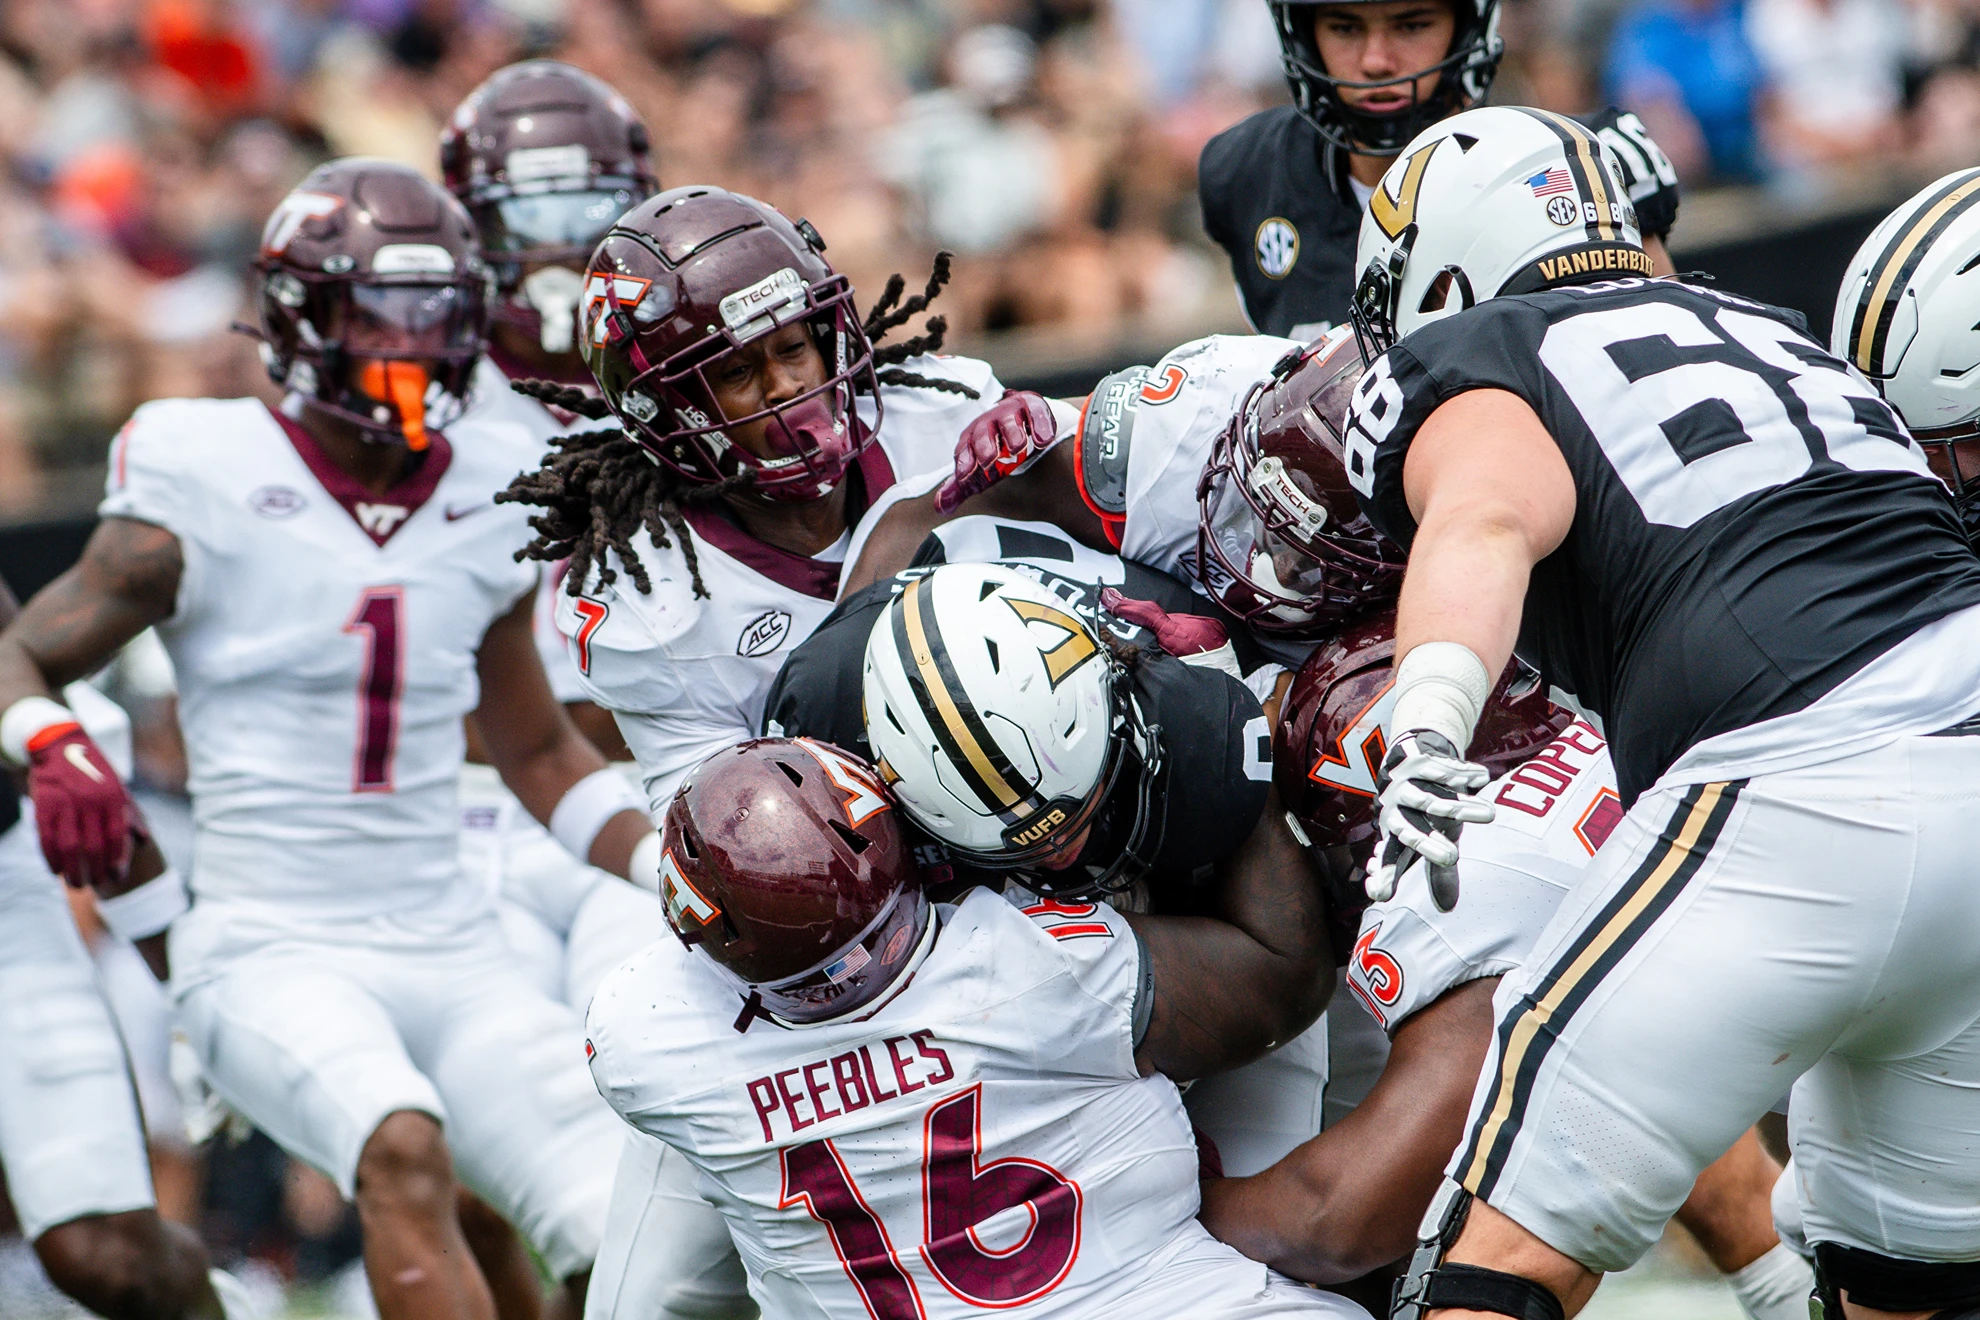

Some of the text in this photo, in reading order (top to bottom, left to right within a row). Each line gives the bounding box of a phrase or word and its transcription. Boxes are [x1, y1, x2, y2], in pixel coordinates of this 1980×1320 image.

[1597, 112, 1678, 202] 16
[1257, 221, 1295, 275] SEC
[1548, 197, 1576, 225] SEC
[738, 279, 780, 307] TECH
[1099, 381, 1126, 463] GEAR
[1342, 353, 1405, 499] 68
[1538, 301, 1953, 529] 68
[354, 502, 408, 536] VT
[1276, 474, 1310, 515] TECH
[573, 594, 610, 678] 7
[747, 613, 782, 650] ACC
[344, 586, 406, 793] 1
[1011, 808, 1067, 847] VUFB
[746, 1028, 954, 1143] PEEBLES
[777, 1081, 1083, 1320] 16
